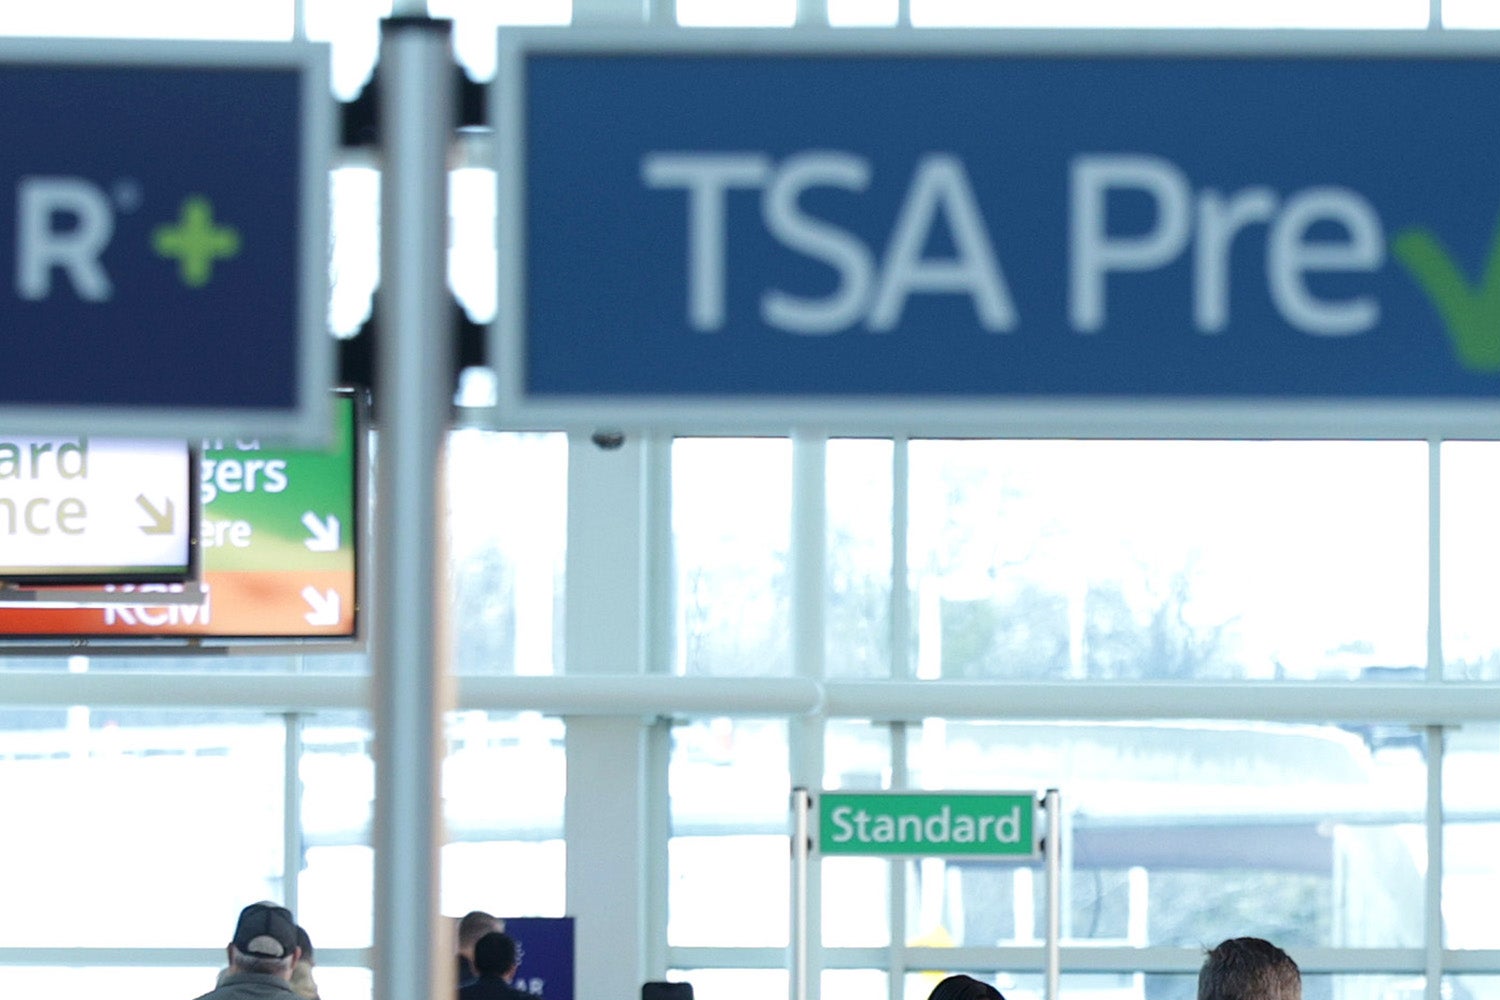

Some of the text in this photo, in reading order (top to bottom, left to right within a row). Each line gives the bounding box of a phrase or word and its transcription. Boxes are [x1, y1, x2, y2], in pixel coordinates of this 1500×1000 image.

[641, 152, 1385, 336] TSA Pre
[831, 805, 1021, 844] Standard
